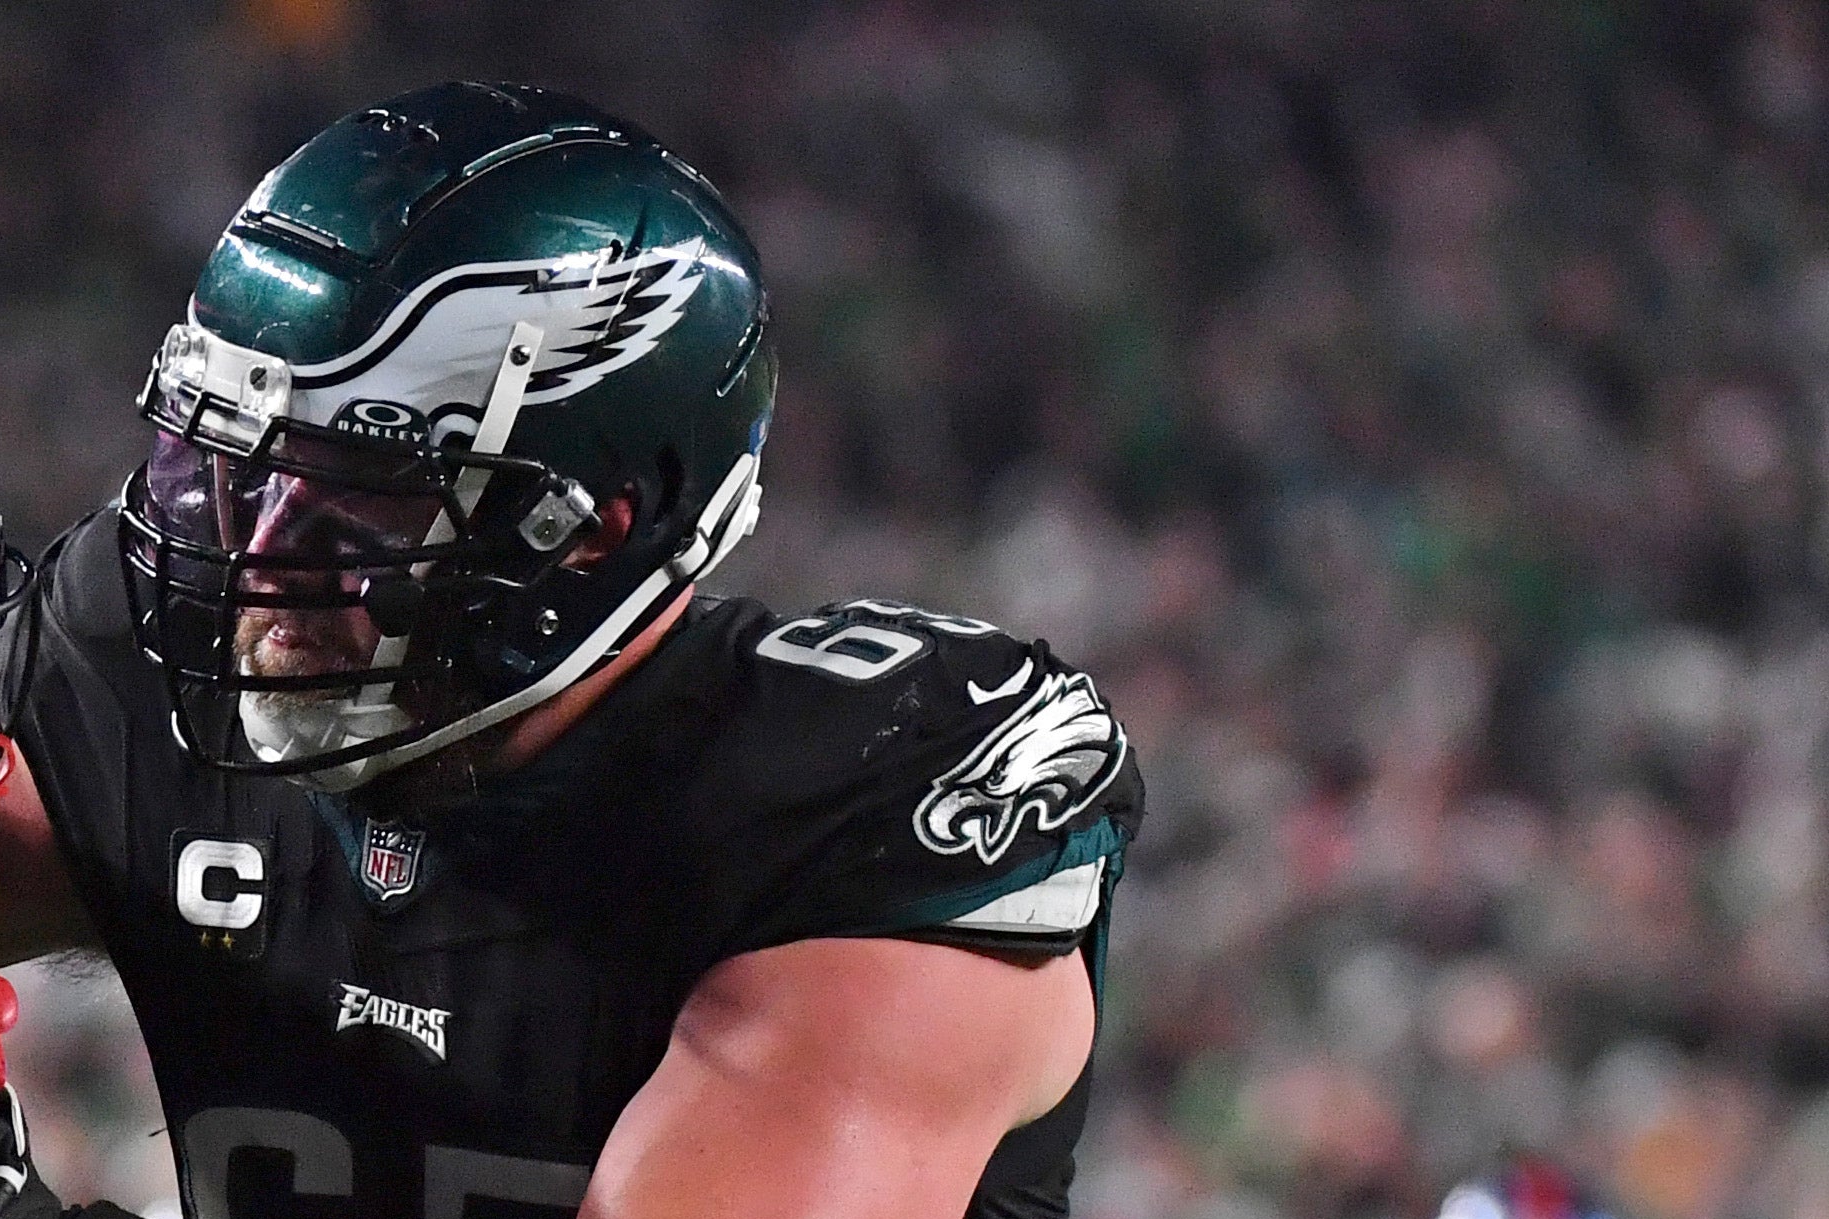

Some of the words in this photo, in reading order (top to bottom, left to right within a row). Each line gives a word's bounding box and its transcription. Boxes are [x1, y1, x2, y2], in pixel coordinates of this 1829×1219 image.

[336, 418, 425, 444] OAKLEY
[176, 839, 264, 930] C
[369, 849, 407, 884] NFL
[335, 982, 452, 1061] EAGLES
